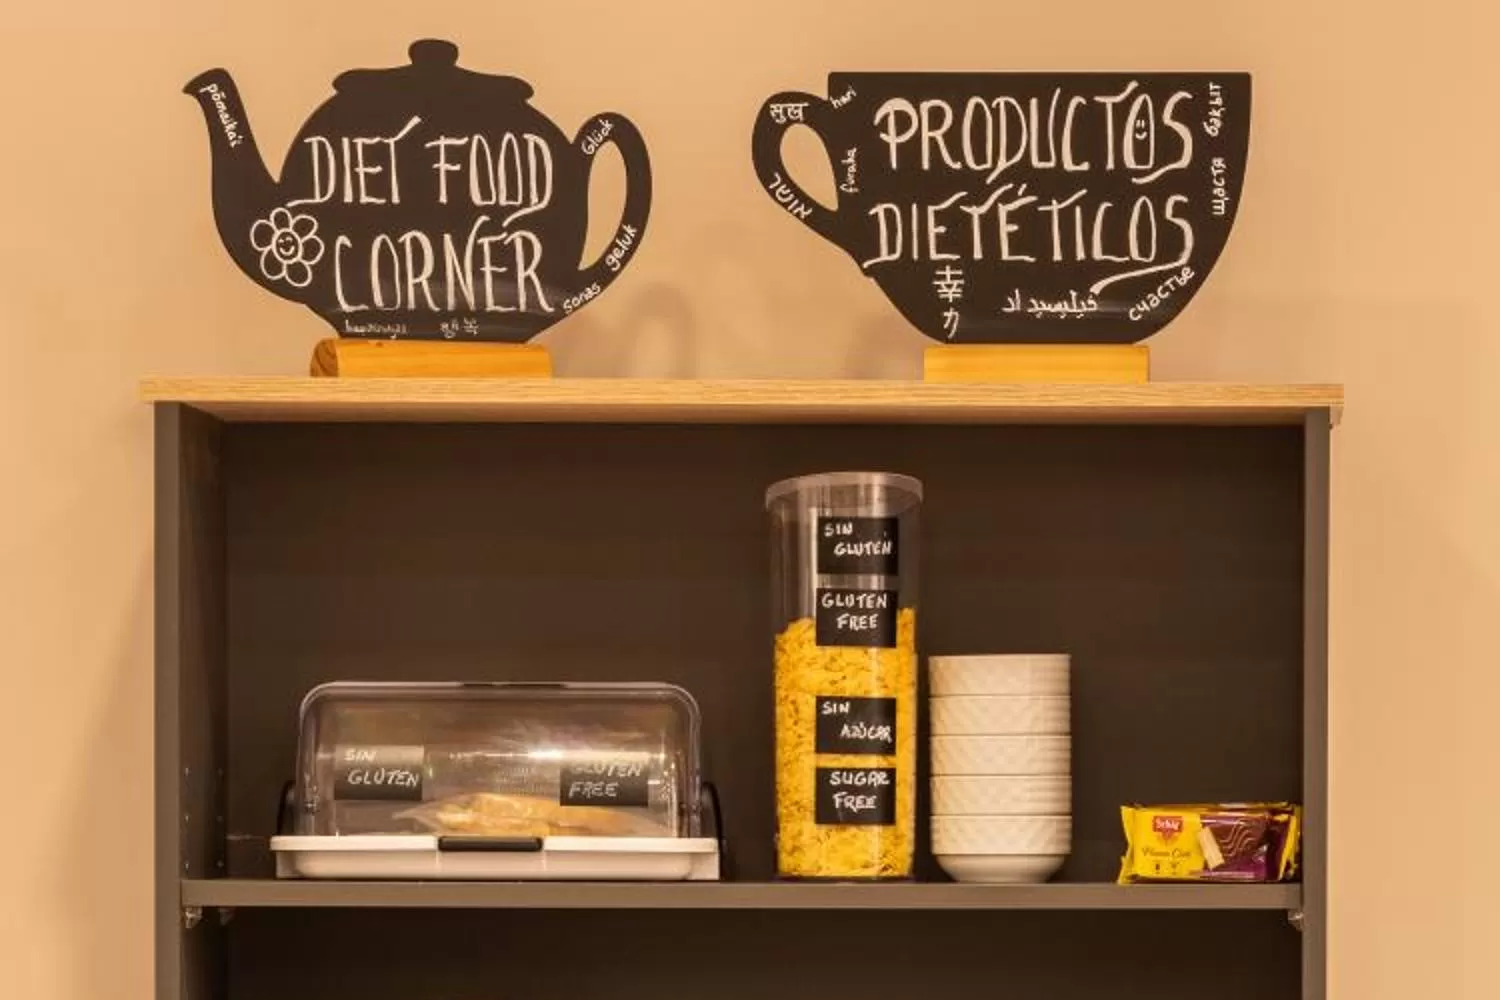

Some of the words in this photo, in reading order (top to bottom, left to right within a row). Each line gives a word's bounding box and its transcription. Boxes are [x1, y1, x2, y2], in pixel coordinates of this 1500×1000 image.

[581, 118, 614, 155] Glück
[873, 80, 1194, 185] PRODUCTOS
[287, 115, 421, 207] DIET
[424, 132, 553, 227] FOOD
[606, 223, 638, 272] geluk
[863, 182, 1196, 295] DIETÉTICOS
[335, 216, 555, 312] CORNER
[823, 521, 853, 537] SIN
[821, 592, 888, 609] GLUTEN
[836, 612, 879, 631] FREE
[821, 701, 851, 715] SIN
[344, 747, 378, 762] SIN
[347, 767, 420, 787] GLUTEN
[570, 761, 643, 777] GLUTEN
[829, 771, 891, 787] SUGAR
[568, 780, 620, 799] FREE
[832, 791, 878, 813] FREE
